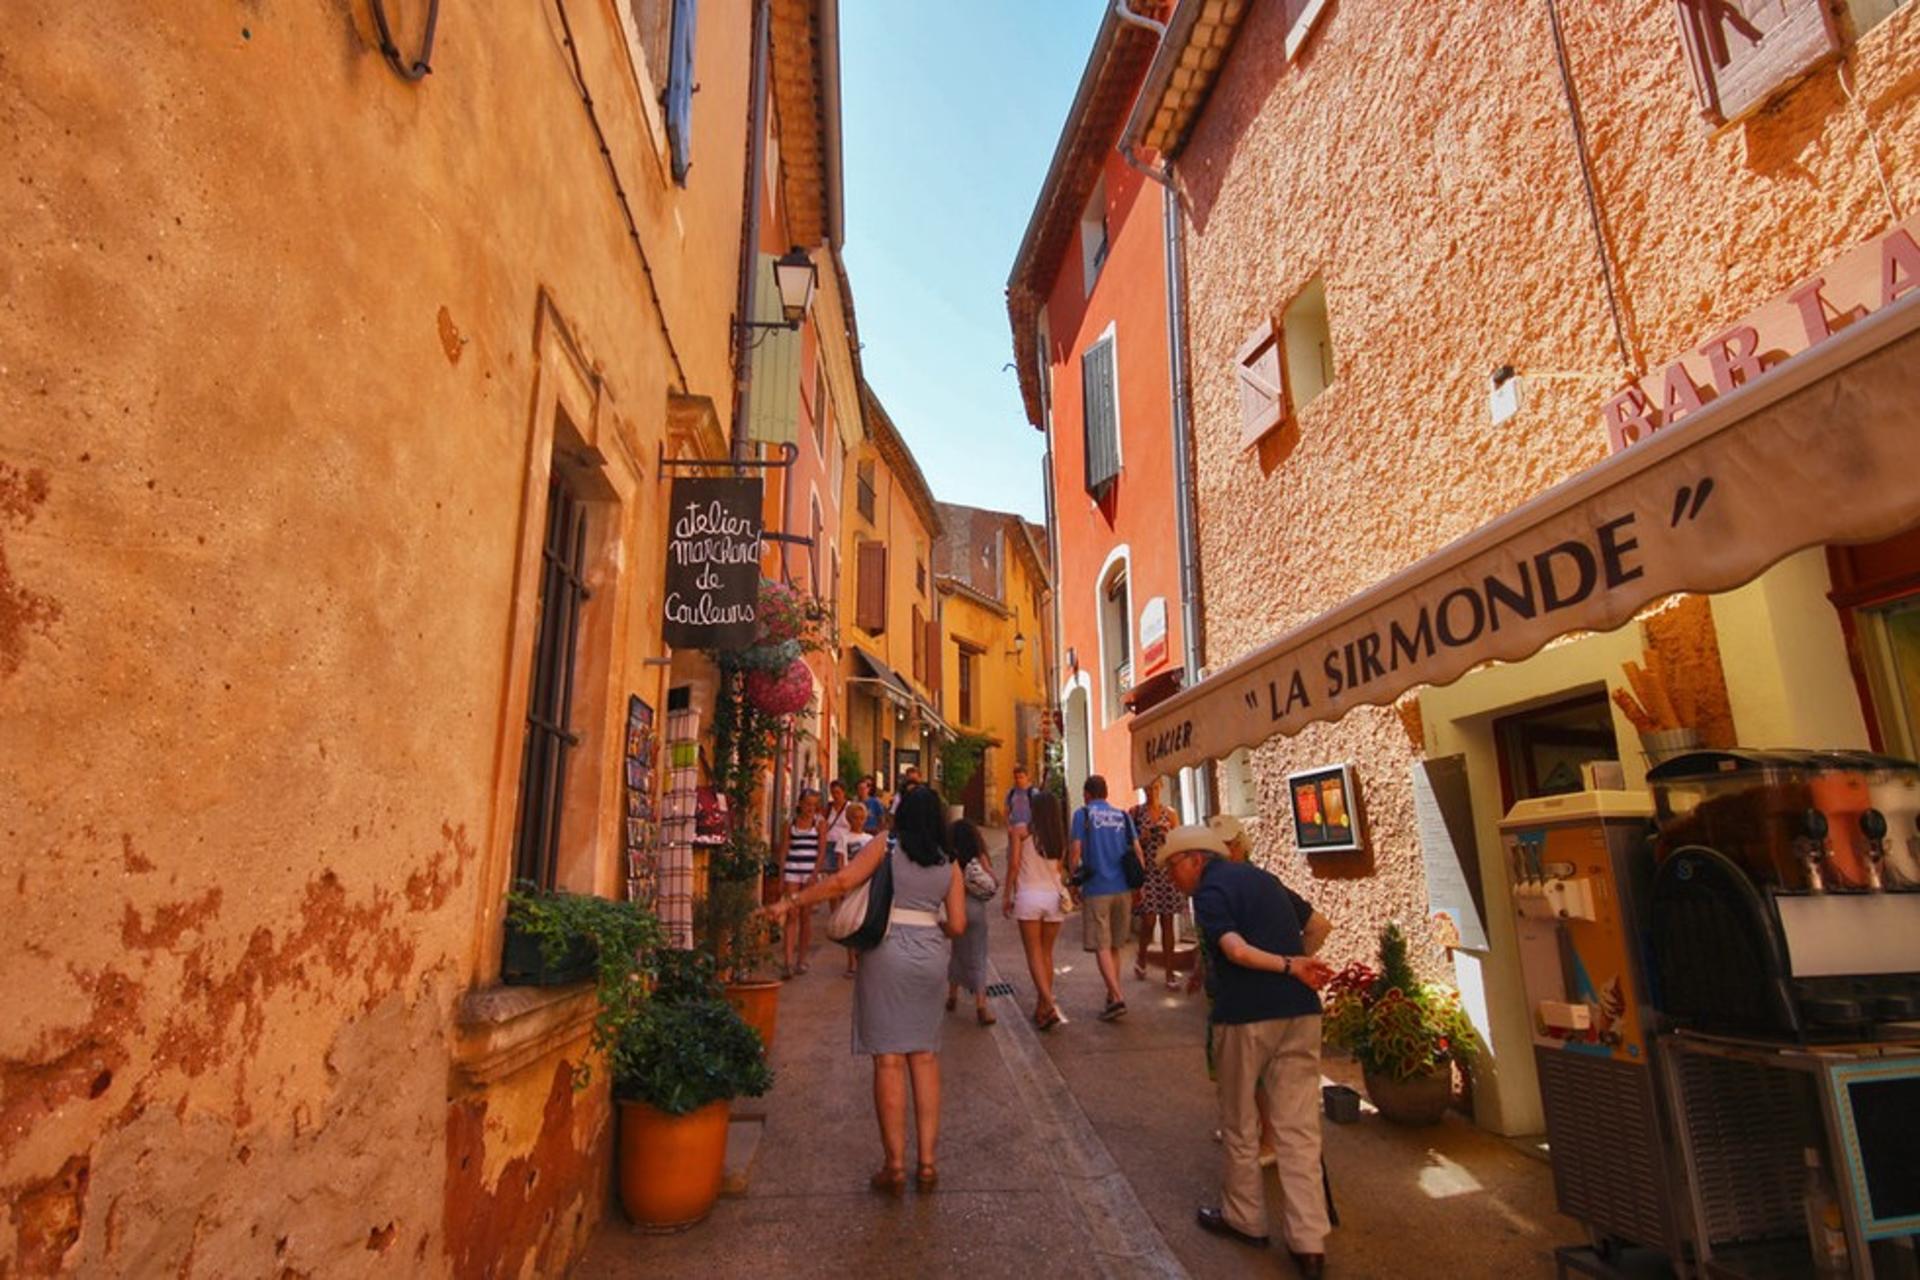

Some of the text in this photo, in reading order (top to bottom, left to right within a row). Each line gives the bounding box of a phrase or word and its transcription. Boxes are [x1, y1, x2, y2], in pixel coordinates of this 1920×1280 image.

[1602, 325, 1766, 455] BAR
[675, 500, 755, 538] atelier
[669, 530, 761, 566] marchand
[695, 563, 725, 590] de
